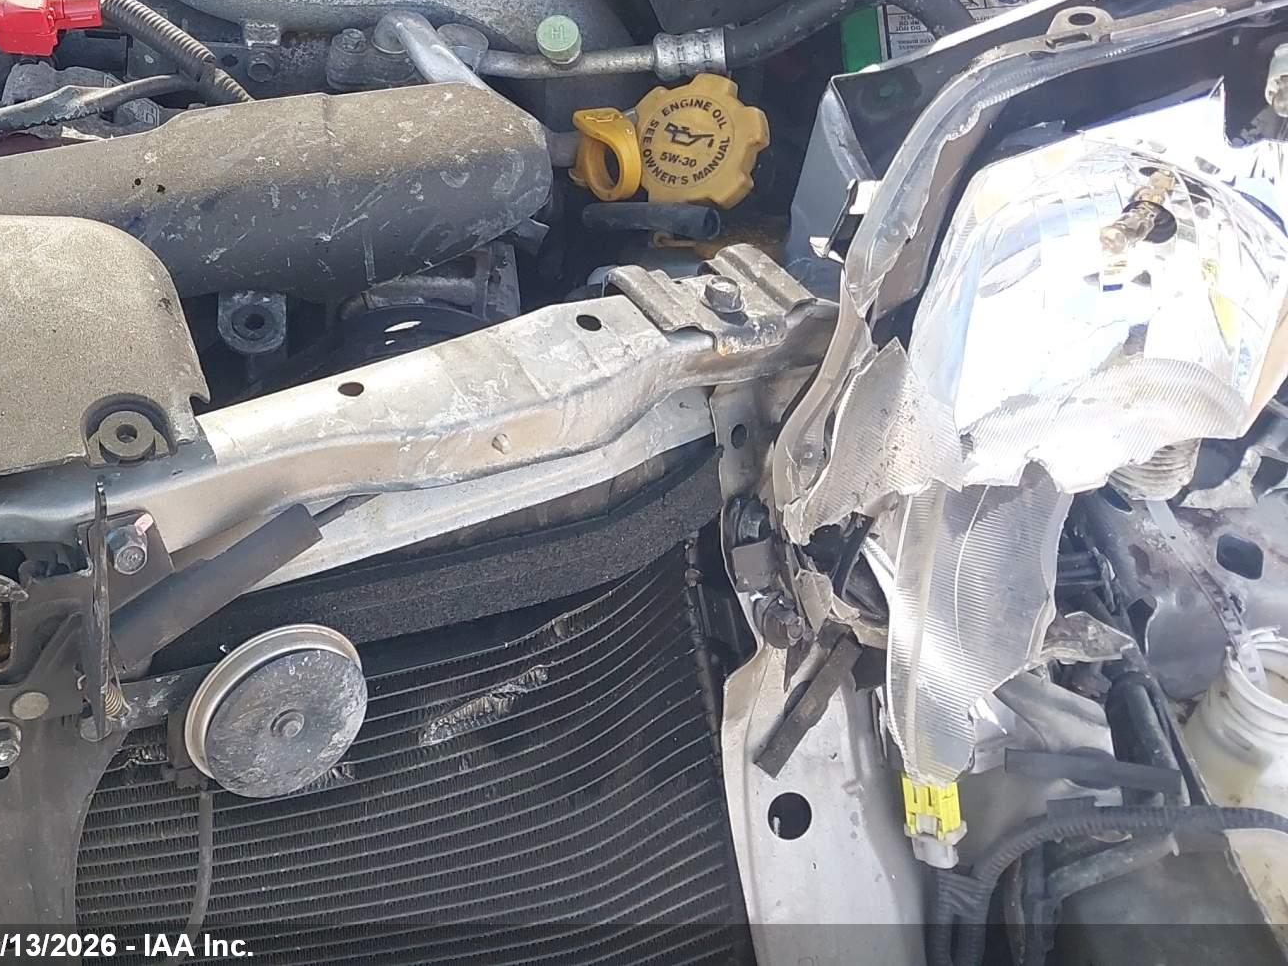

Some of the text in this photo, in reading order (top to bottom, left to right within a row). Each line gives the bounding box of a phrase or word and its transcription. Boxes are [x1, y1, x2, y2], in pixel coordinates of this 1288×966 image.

[661, 98, 727, 130] ENGINE OIL
[642, 119, 730, 185] SEE OWNER'S MANUAL
[659, 151, 697, 168] 5W-30
